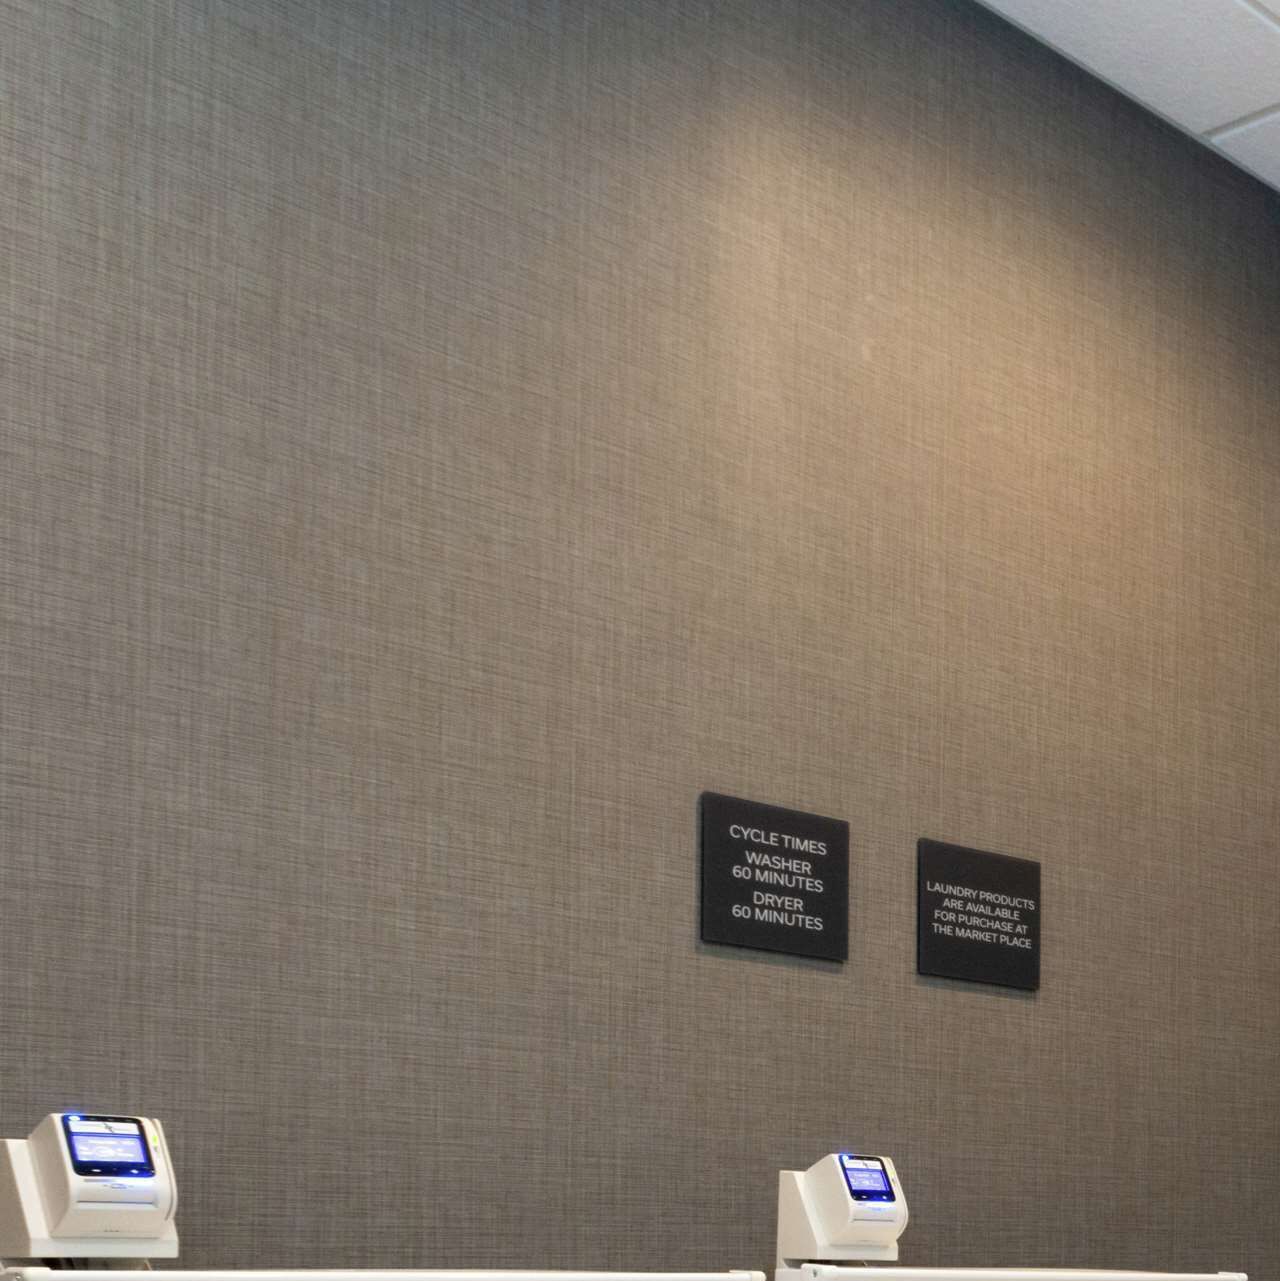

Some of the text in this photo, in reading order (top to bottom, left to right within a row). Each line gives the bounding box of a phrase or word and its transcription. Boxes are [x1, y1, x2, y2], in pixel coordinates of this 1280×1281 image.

[729, 824, 828, 856] CYCLE TIMES
[745, 850, 812, 875] WASHER
[732, 865, 824, 893] 60 MINUTES
[753, 891, 804, 912] DRYER
[926, 880, 1036, 911] LAUNDRY PRODUCTS
[732, 904, 824, 931] 60 MINUTES
[934, 909, 1029, 935] FOR PURCHASE AT
[943, 898, 1020, 921] ARE AVAILABLE
[931, 922, 1033, 950] THE MARKET PLACE
